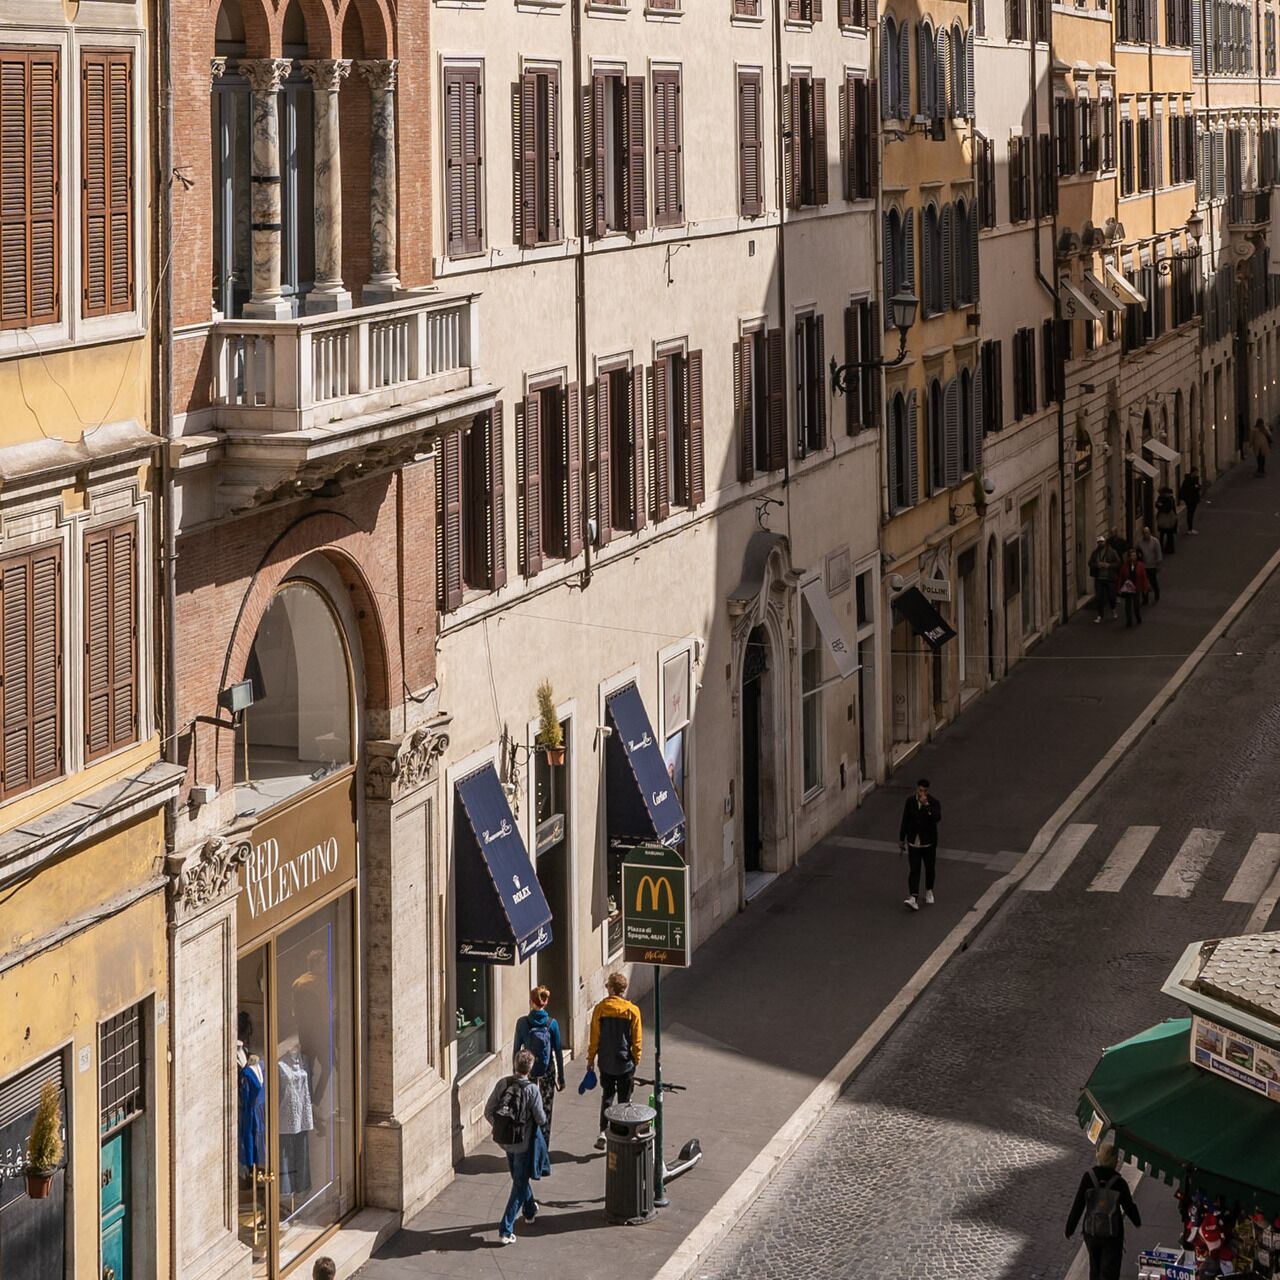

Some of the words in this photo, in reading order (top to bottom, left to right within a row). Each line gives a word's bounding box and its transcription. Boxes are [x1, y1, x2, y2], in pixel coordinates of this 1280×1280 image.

[246, 837, 279, 884] RED
[246, 836, 338, 920] VALENTINO
[512, 885, 532, 905] ROLEX
[1166, 1268, 1190, 1280] €1,00
